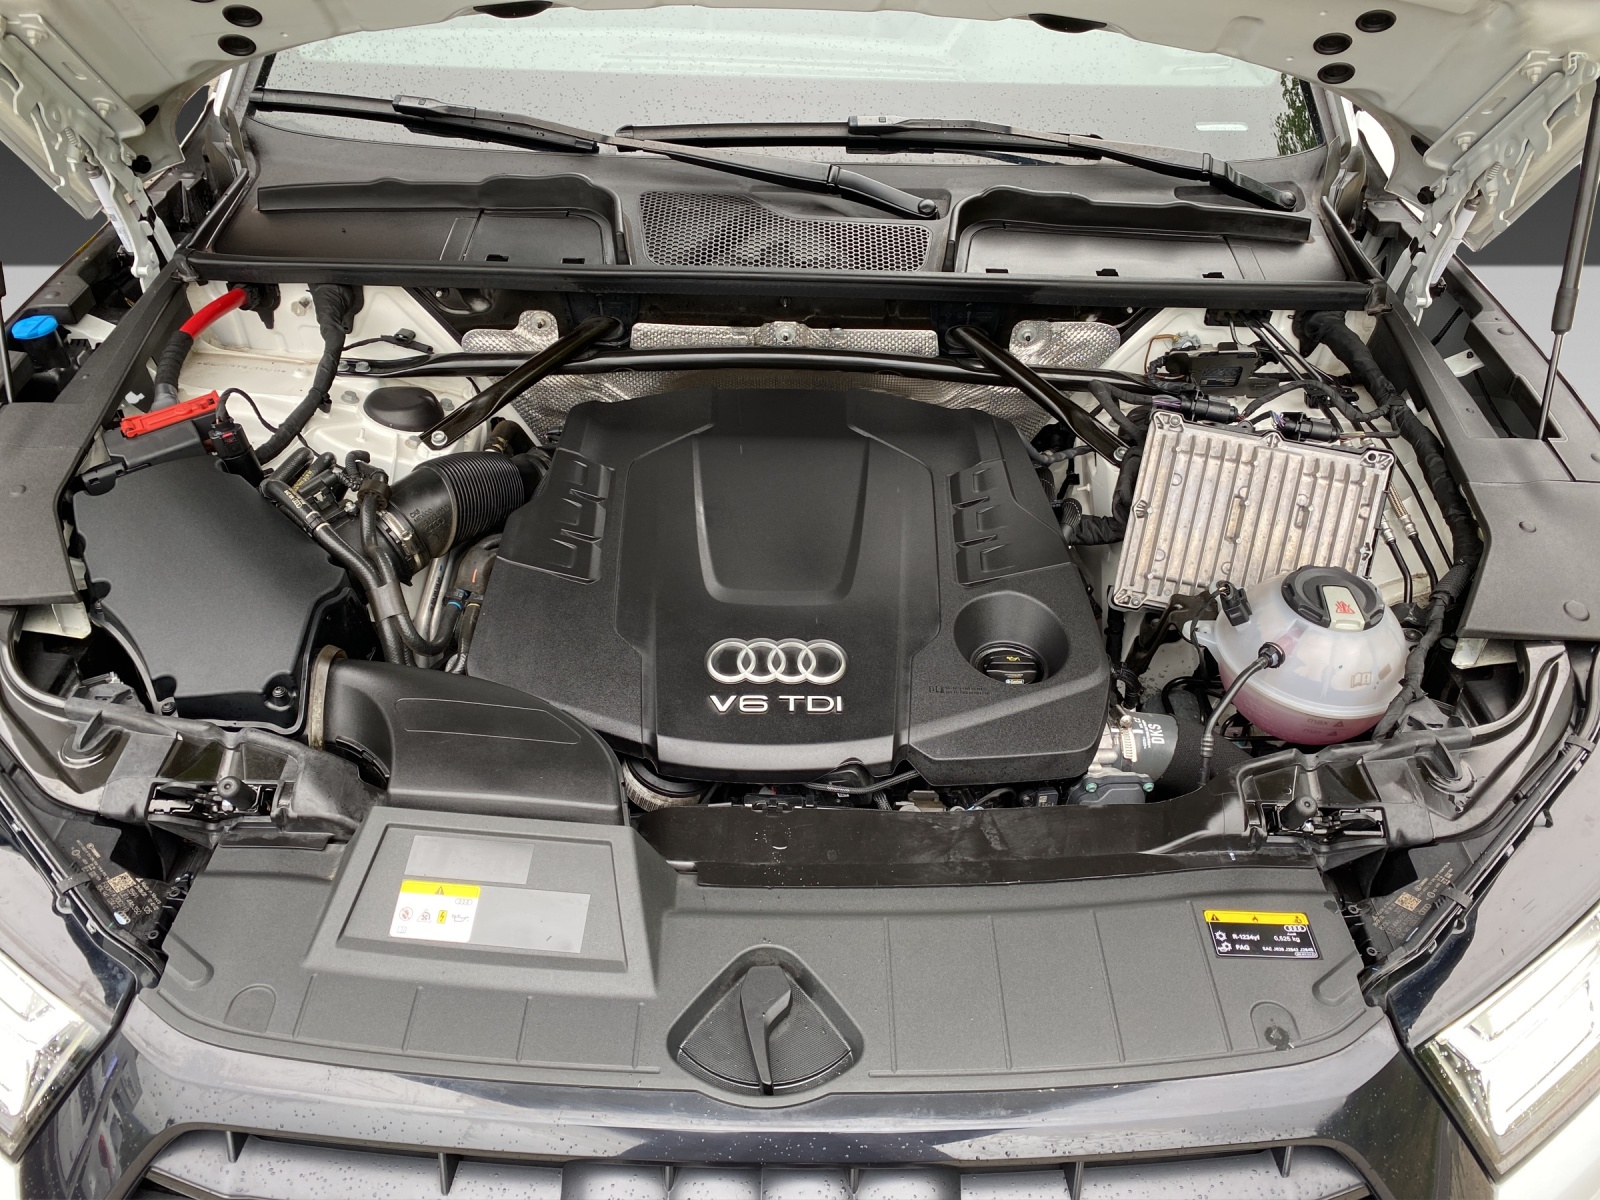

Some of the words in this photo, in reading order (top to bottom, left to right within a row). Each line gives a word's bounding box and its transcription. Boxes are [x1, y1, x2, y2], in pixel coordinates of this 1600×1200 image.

[709, 694, 769, 713] V6
[778, 695, 843, 713] TDI
[1306, 718, 1328, 726] max
[1147, 723, 1166, 745] DKS
